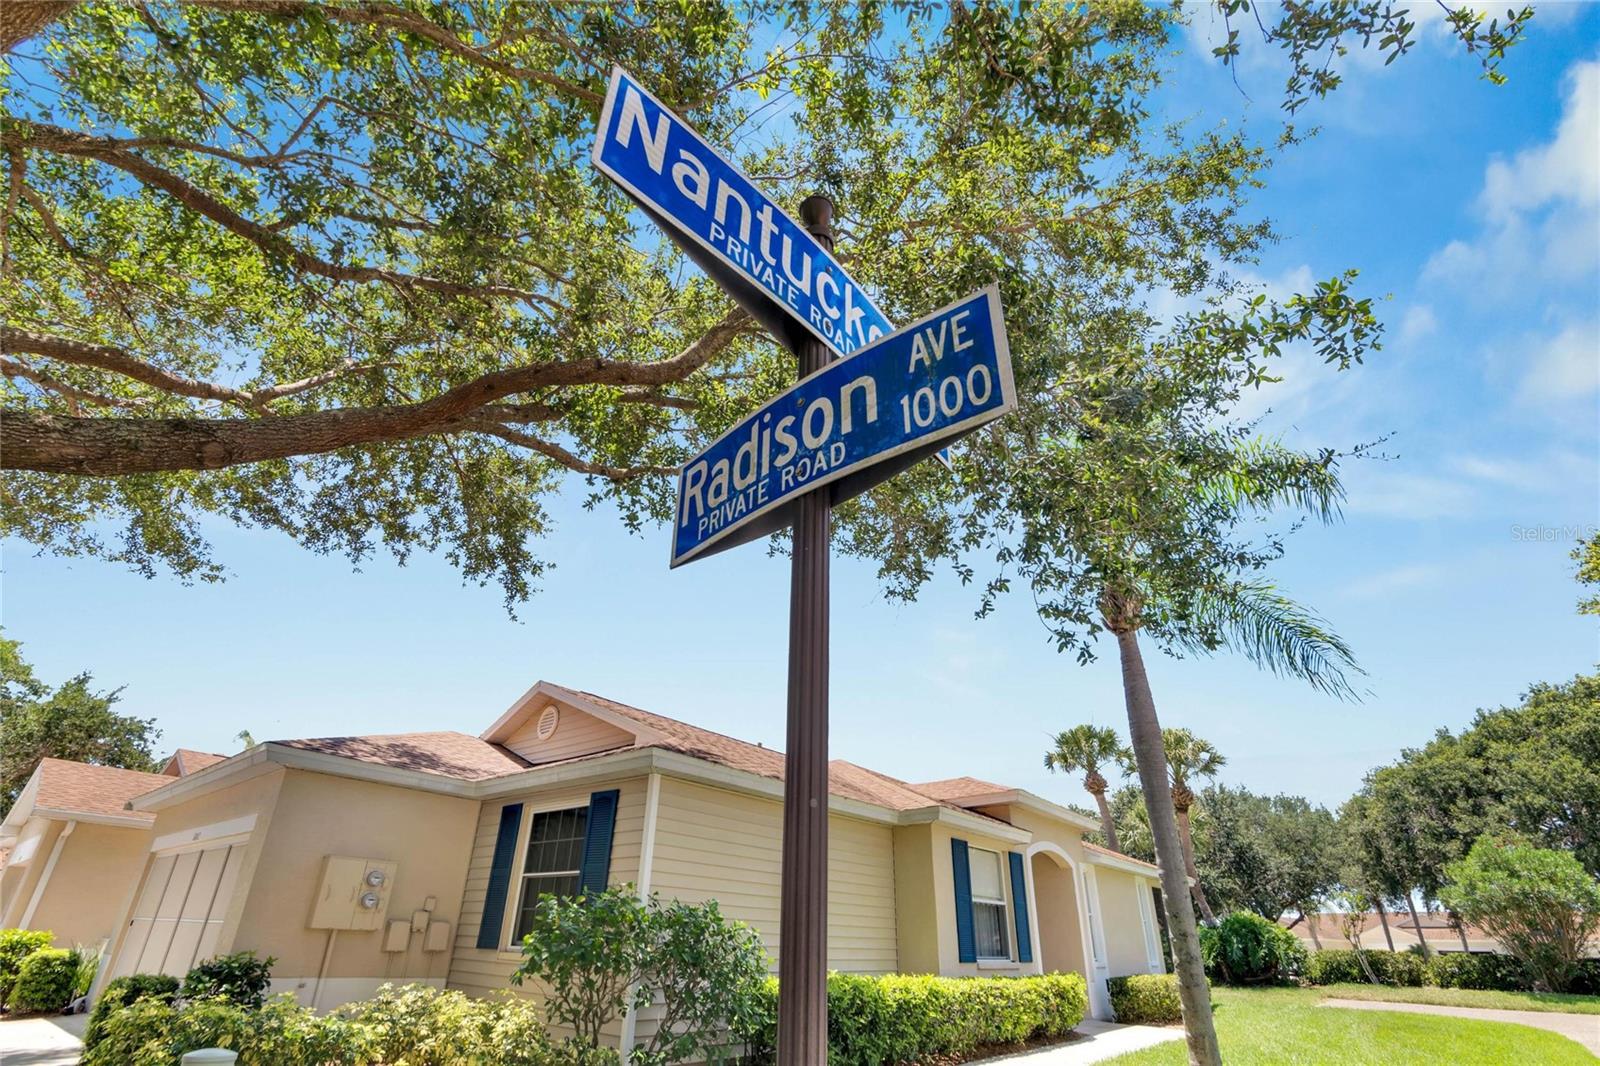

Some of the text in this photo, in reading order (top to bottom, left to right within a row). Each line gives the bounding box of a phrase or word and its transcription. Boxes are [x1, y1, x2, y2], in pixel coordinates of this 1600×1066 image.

[709, 222, 855, 355] PRIVATE ROAD
[909, 310, 974, 374] AVE
[900, 364, 992, 434] 1000
[682, 375, 878, 528] Radison
[698, 441, 846, 540] PRIVATE ROAD
